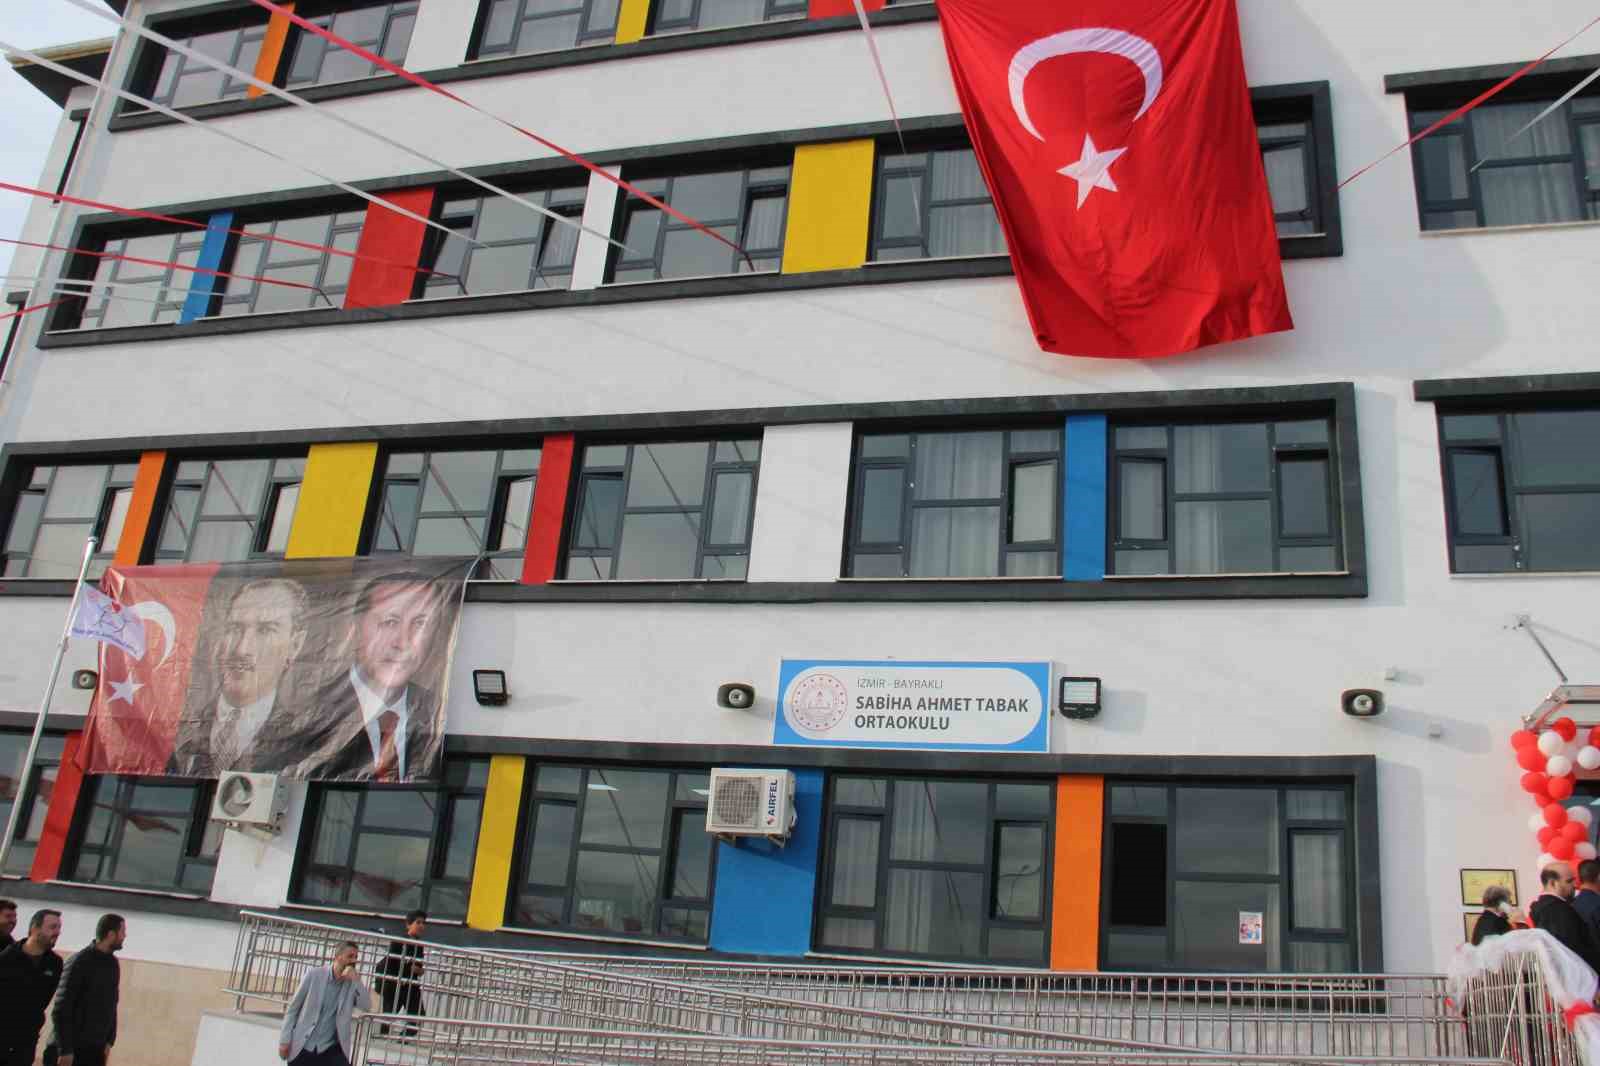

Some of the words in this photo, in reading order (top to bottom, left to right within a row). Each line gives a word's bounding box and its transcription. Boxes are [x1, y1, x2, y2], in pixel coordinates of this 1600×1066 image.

[894, 679, 943, 688] BAYRAKLI
[855, 693, 912, 711] SABİHA
[916, 697, 972, 711] AHMET
[975, 698, 1029, 713] TABAK
[854, 714, 950, 730] ORTAOKULU
[767, 780, 778, 816] AIRFEL
